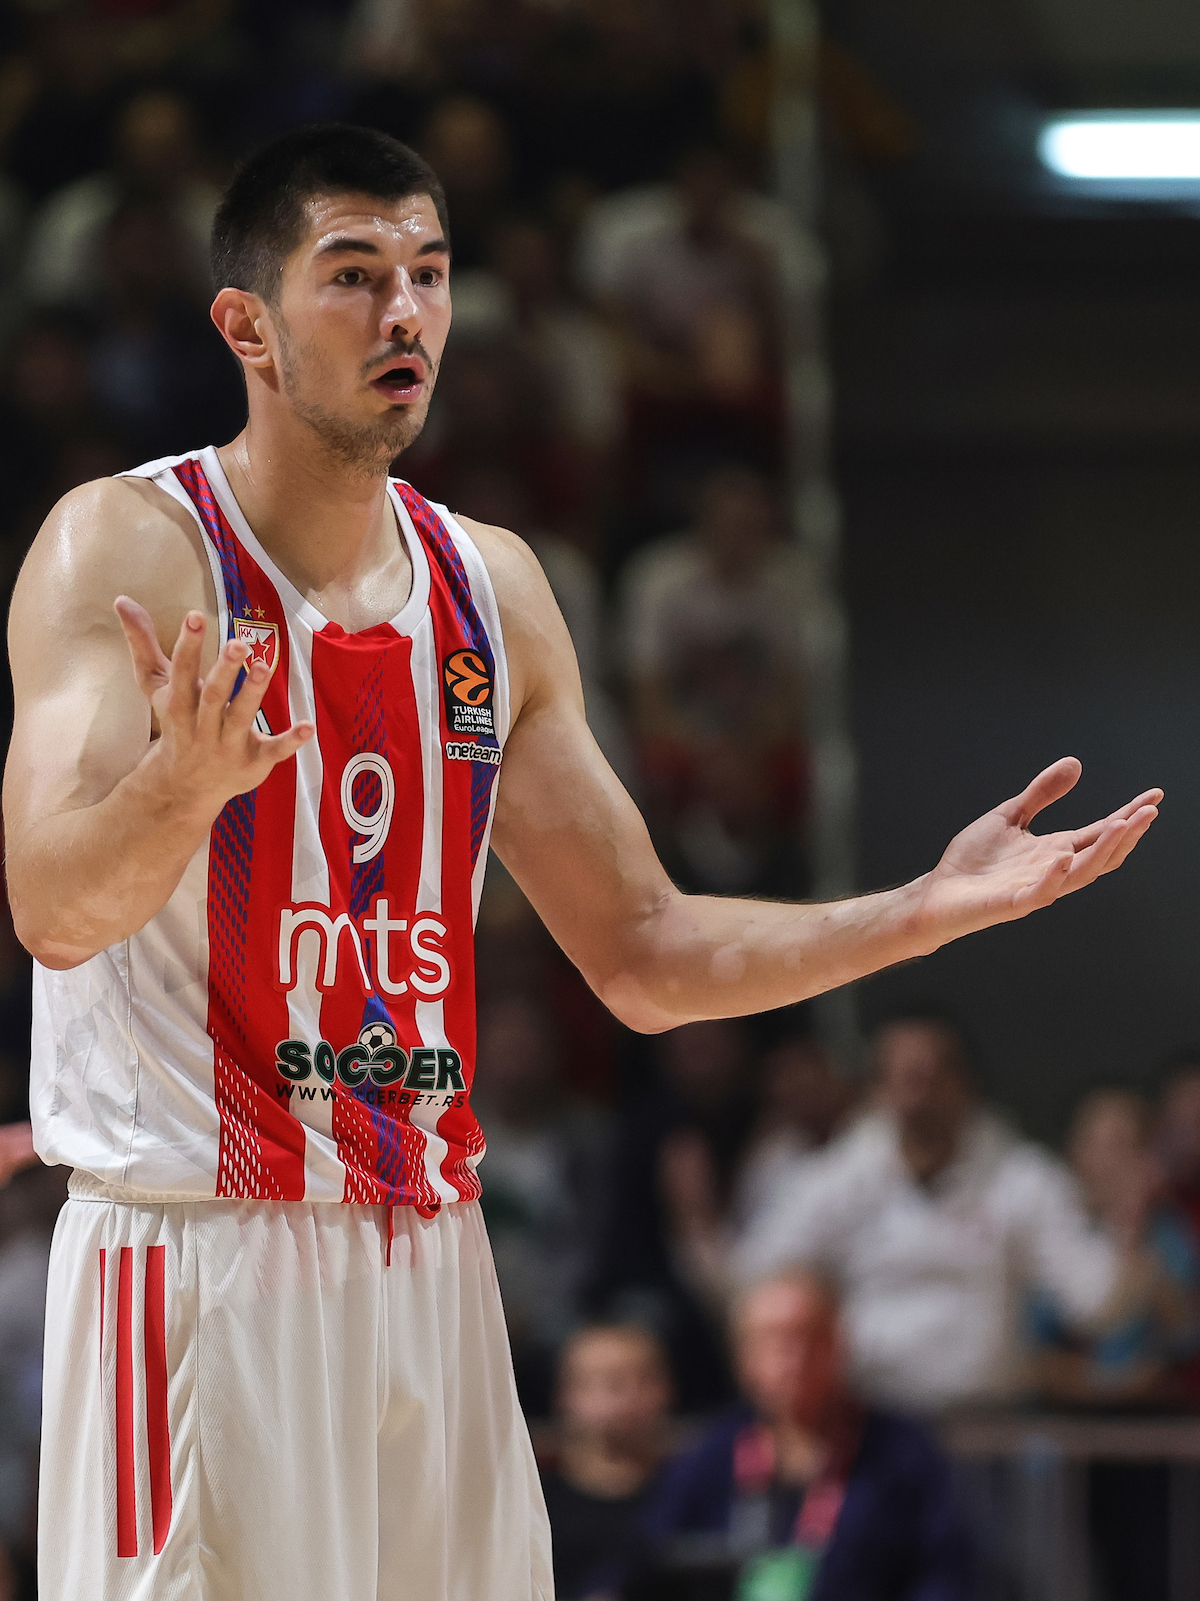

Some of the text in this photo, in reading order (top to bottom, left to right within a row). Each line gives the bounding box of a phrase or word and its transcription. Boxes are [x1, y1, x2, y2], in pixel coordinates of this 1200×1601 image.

[452, 705, 492, 718] TURKISH
[453, 714, 493, 727] AIRLINES
[446, 741, 502, 765] oneteam
[340, 752, 395, 865] 9
[278, 898, 451, 996] mts
[274, 1038, 467, 1092] SOCCER
